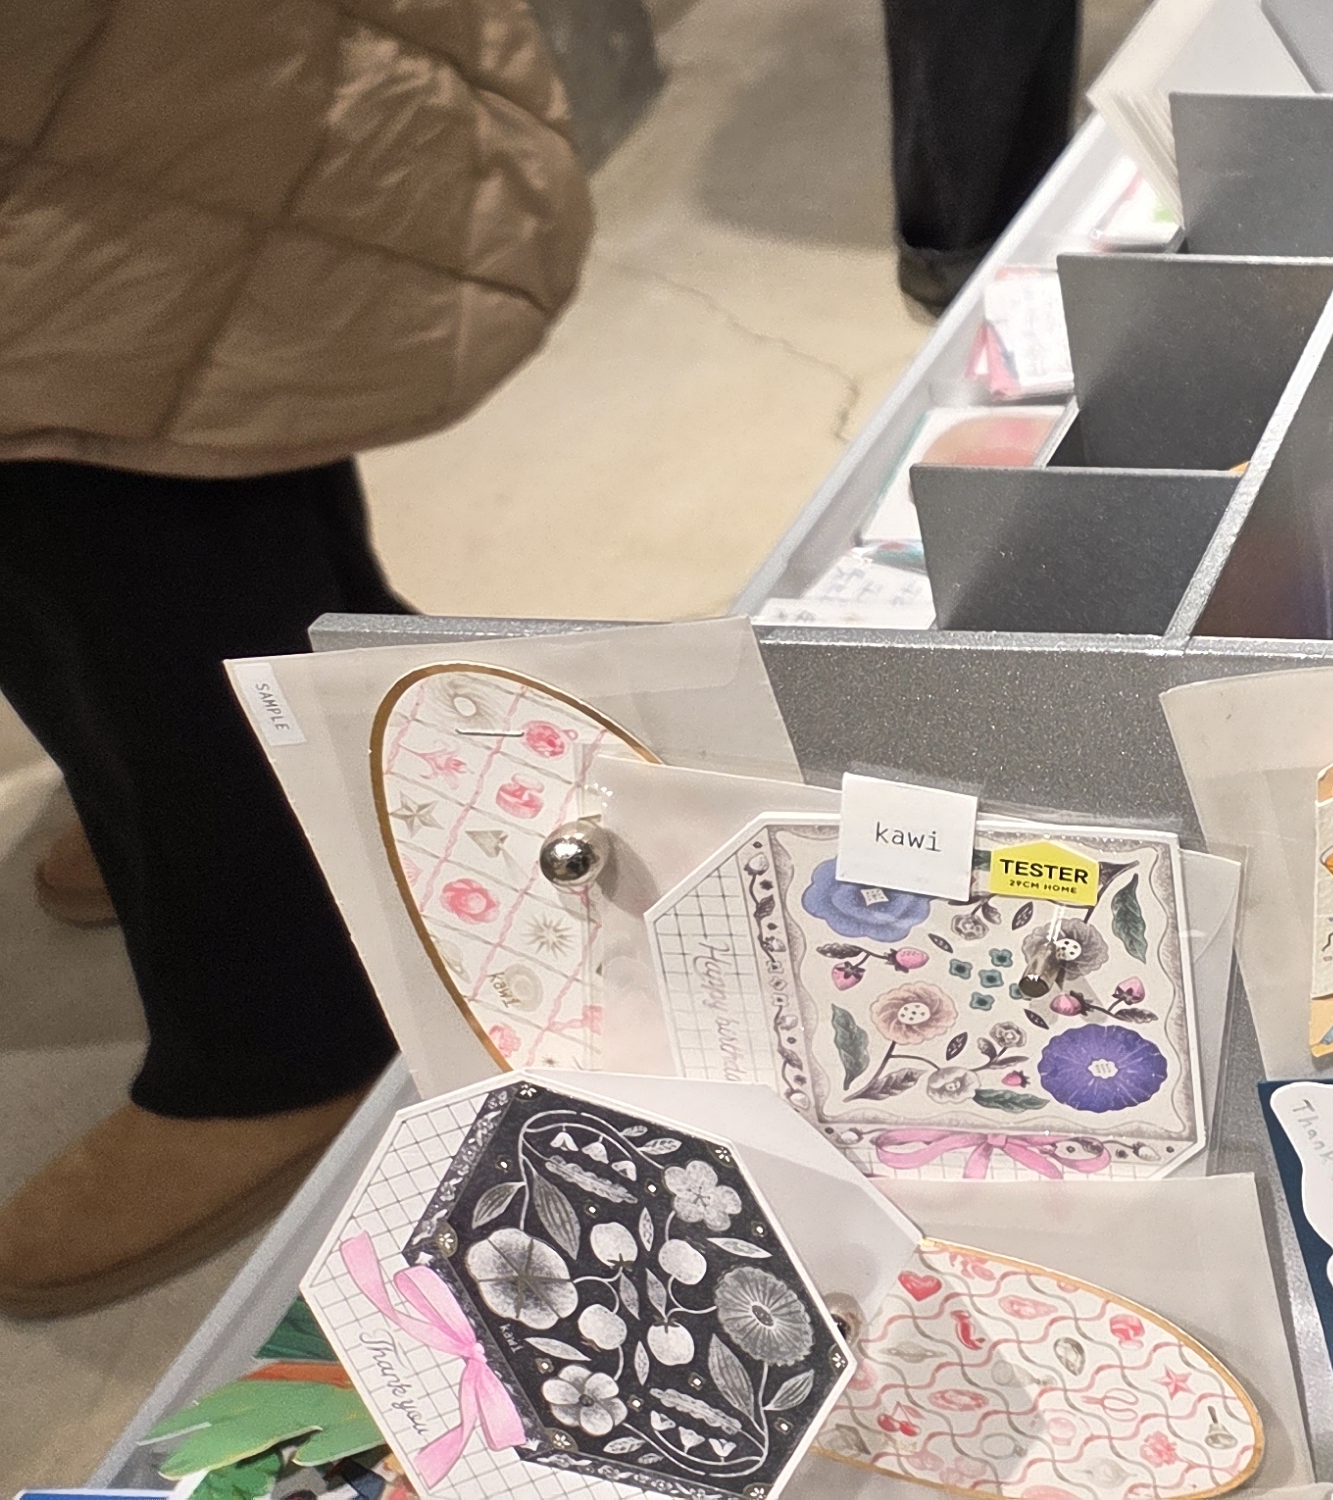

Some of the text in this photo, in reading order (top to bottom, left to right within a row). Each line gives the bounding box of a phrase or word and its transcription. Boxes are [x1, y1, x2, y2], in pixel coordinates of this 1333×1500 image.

[255, 683, 290, 731] SAMPLE
[875, 821, 942, 852] kawi
[1000, 858, 1089, 884] TESTER
[1009, 879, 1078, 894] 29CM HOME
[693, 940, 747, 1081] Happy birthda
[359, 1327, 430, 1436] Thank you
